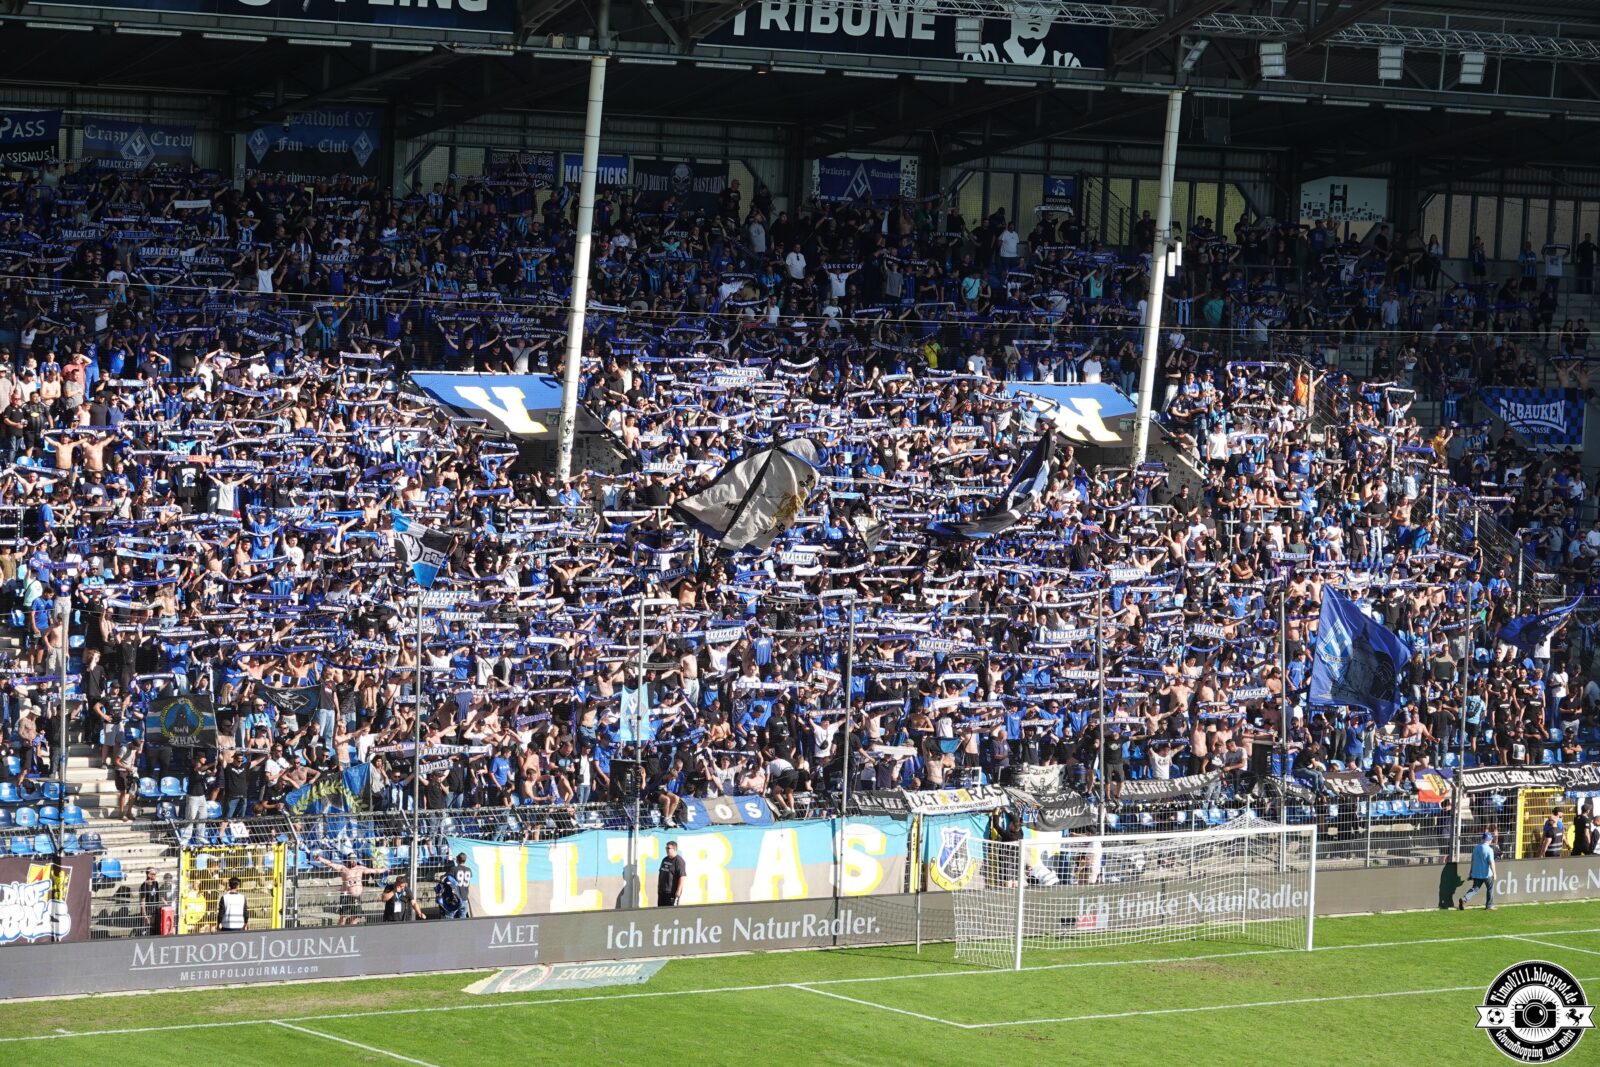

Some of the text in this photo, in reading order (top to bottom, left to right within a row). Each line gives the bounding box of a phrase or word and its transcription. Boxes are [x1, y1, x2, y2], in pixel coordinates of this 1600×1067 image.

[0, 117, 46, 139] PASS
[85, 124, 193, 148] Crazy Crew
[274, 137, 349, 153] Fan Club
[649, 174, 669, 191] DIRTY
[692, 175, 727, 193] BASTARDS
[1499, 397, 1566, 426] RABAUKEN
[1463, 771, 1505, 787] KOLLEKTIV
[1506, 770, 1533, 784] SECHS
[457, 870, 471, 887] 99
[473, 822, 887, 915] ULTRAS
[1496, 868, 1518, 895] ch
[1525, 868, 1579, 894] trinke
[1079, 895, 1109, 917] Ich
[1118, 891, 1178, 918] trinke
[606, 909, 880, 949] Ich trinke NaturRadler.
[180, 965, 319, 982] METROPOLJOURNAL.com
